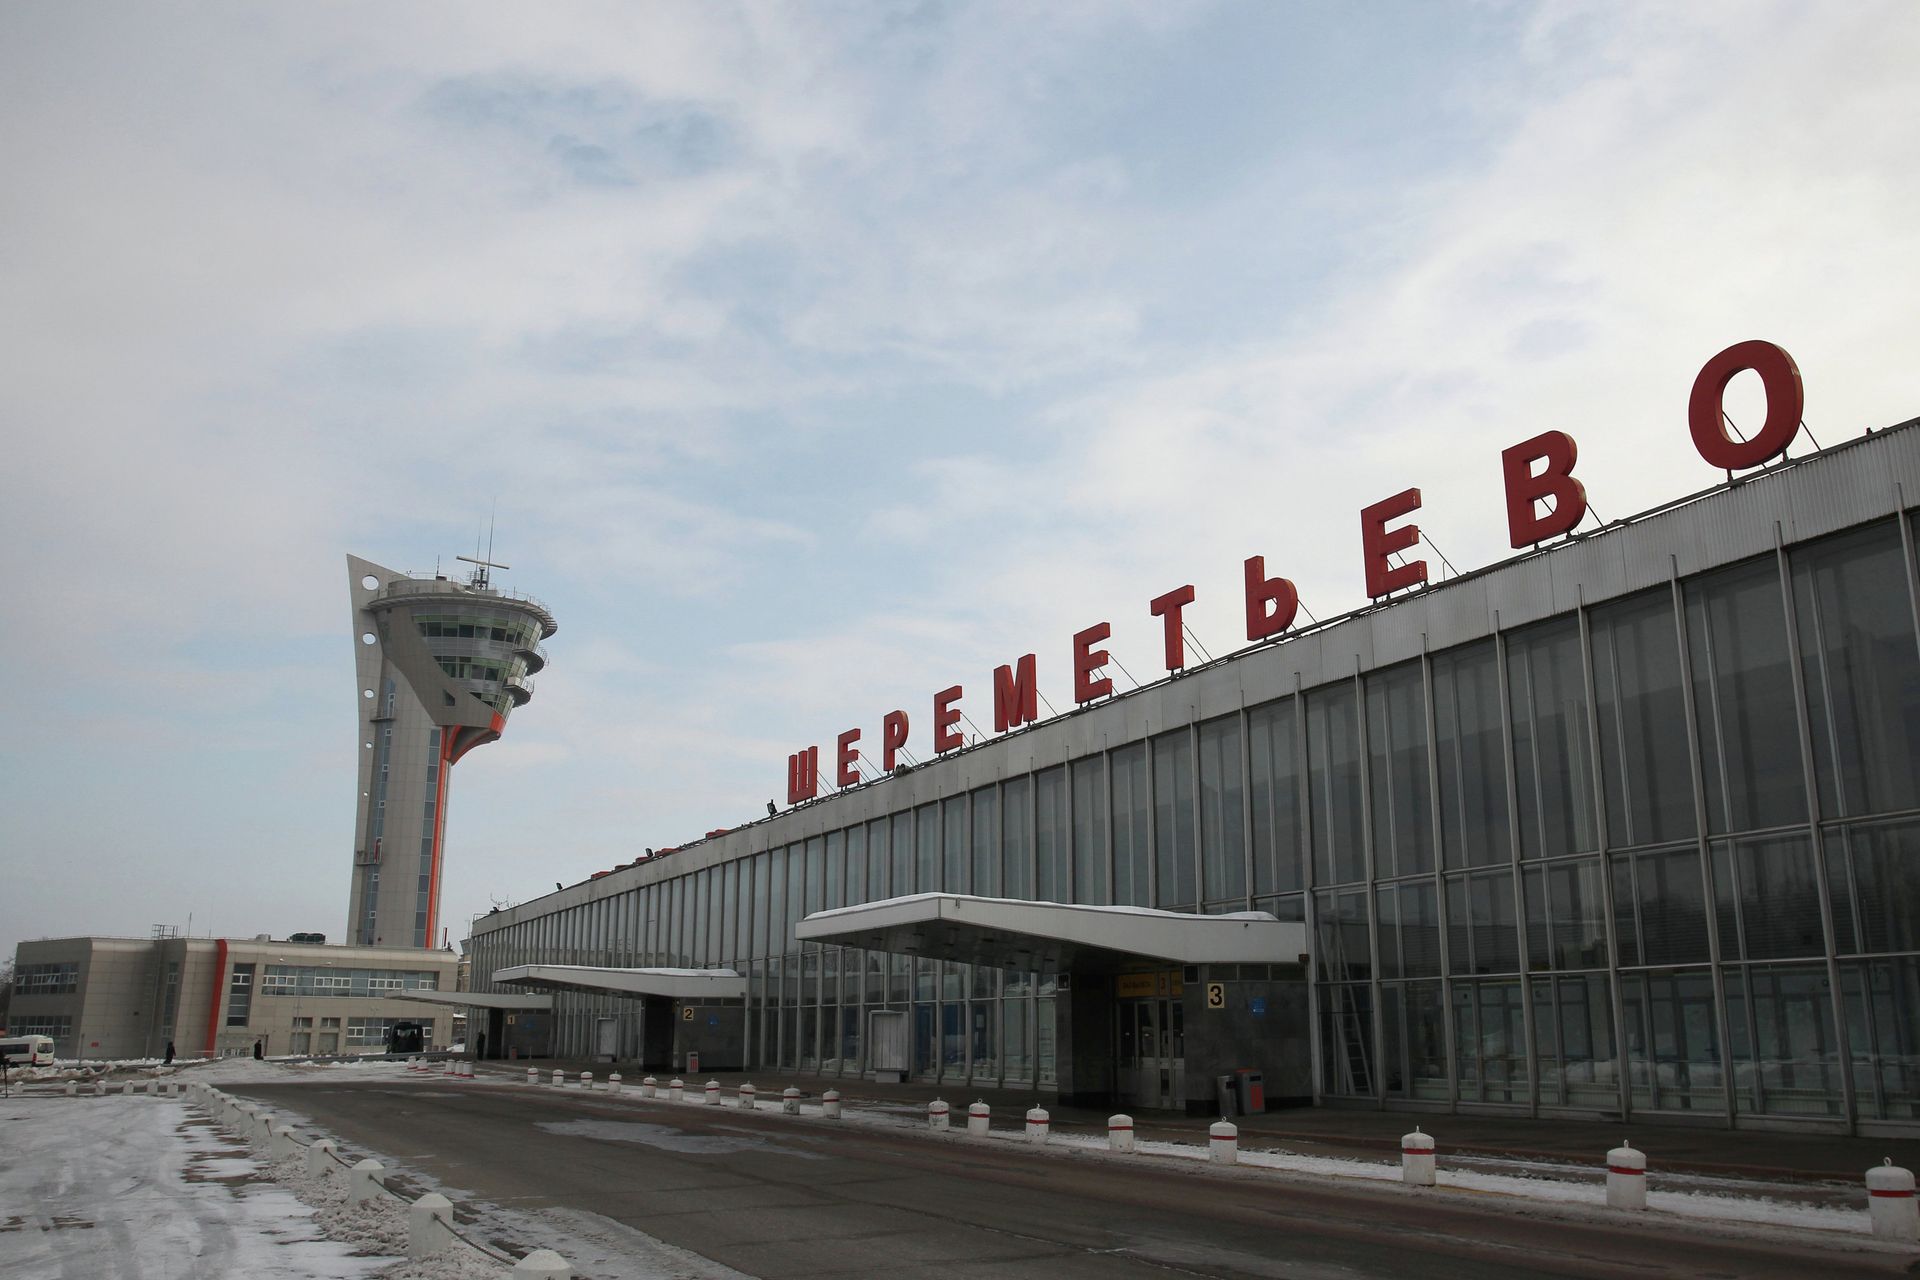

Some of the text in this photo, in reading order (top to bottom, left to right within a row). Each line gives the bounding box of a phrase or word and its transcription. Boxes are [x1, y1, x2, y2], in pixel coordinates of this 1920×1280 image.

[788, 339, 1804, 804] ШЕРЕМЕТЬЕВО
[1210, 985, 1223, 1006] 3
[684, 1008, 693, 1020] 2
